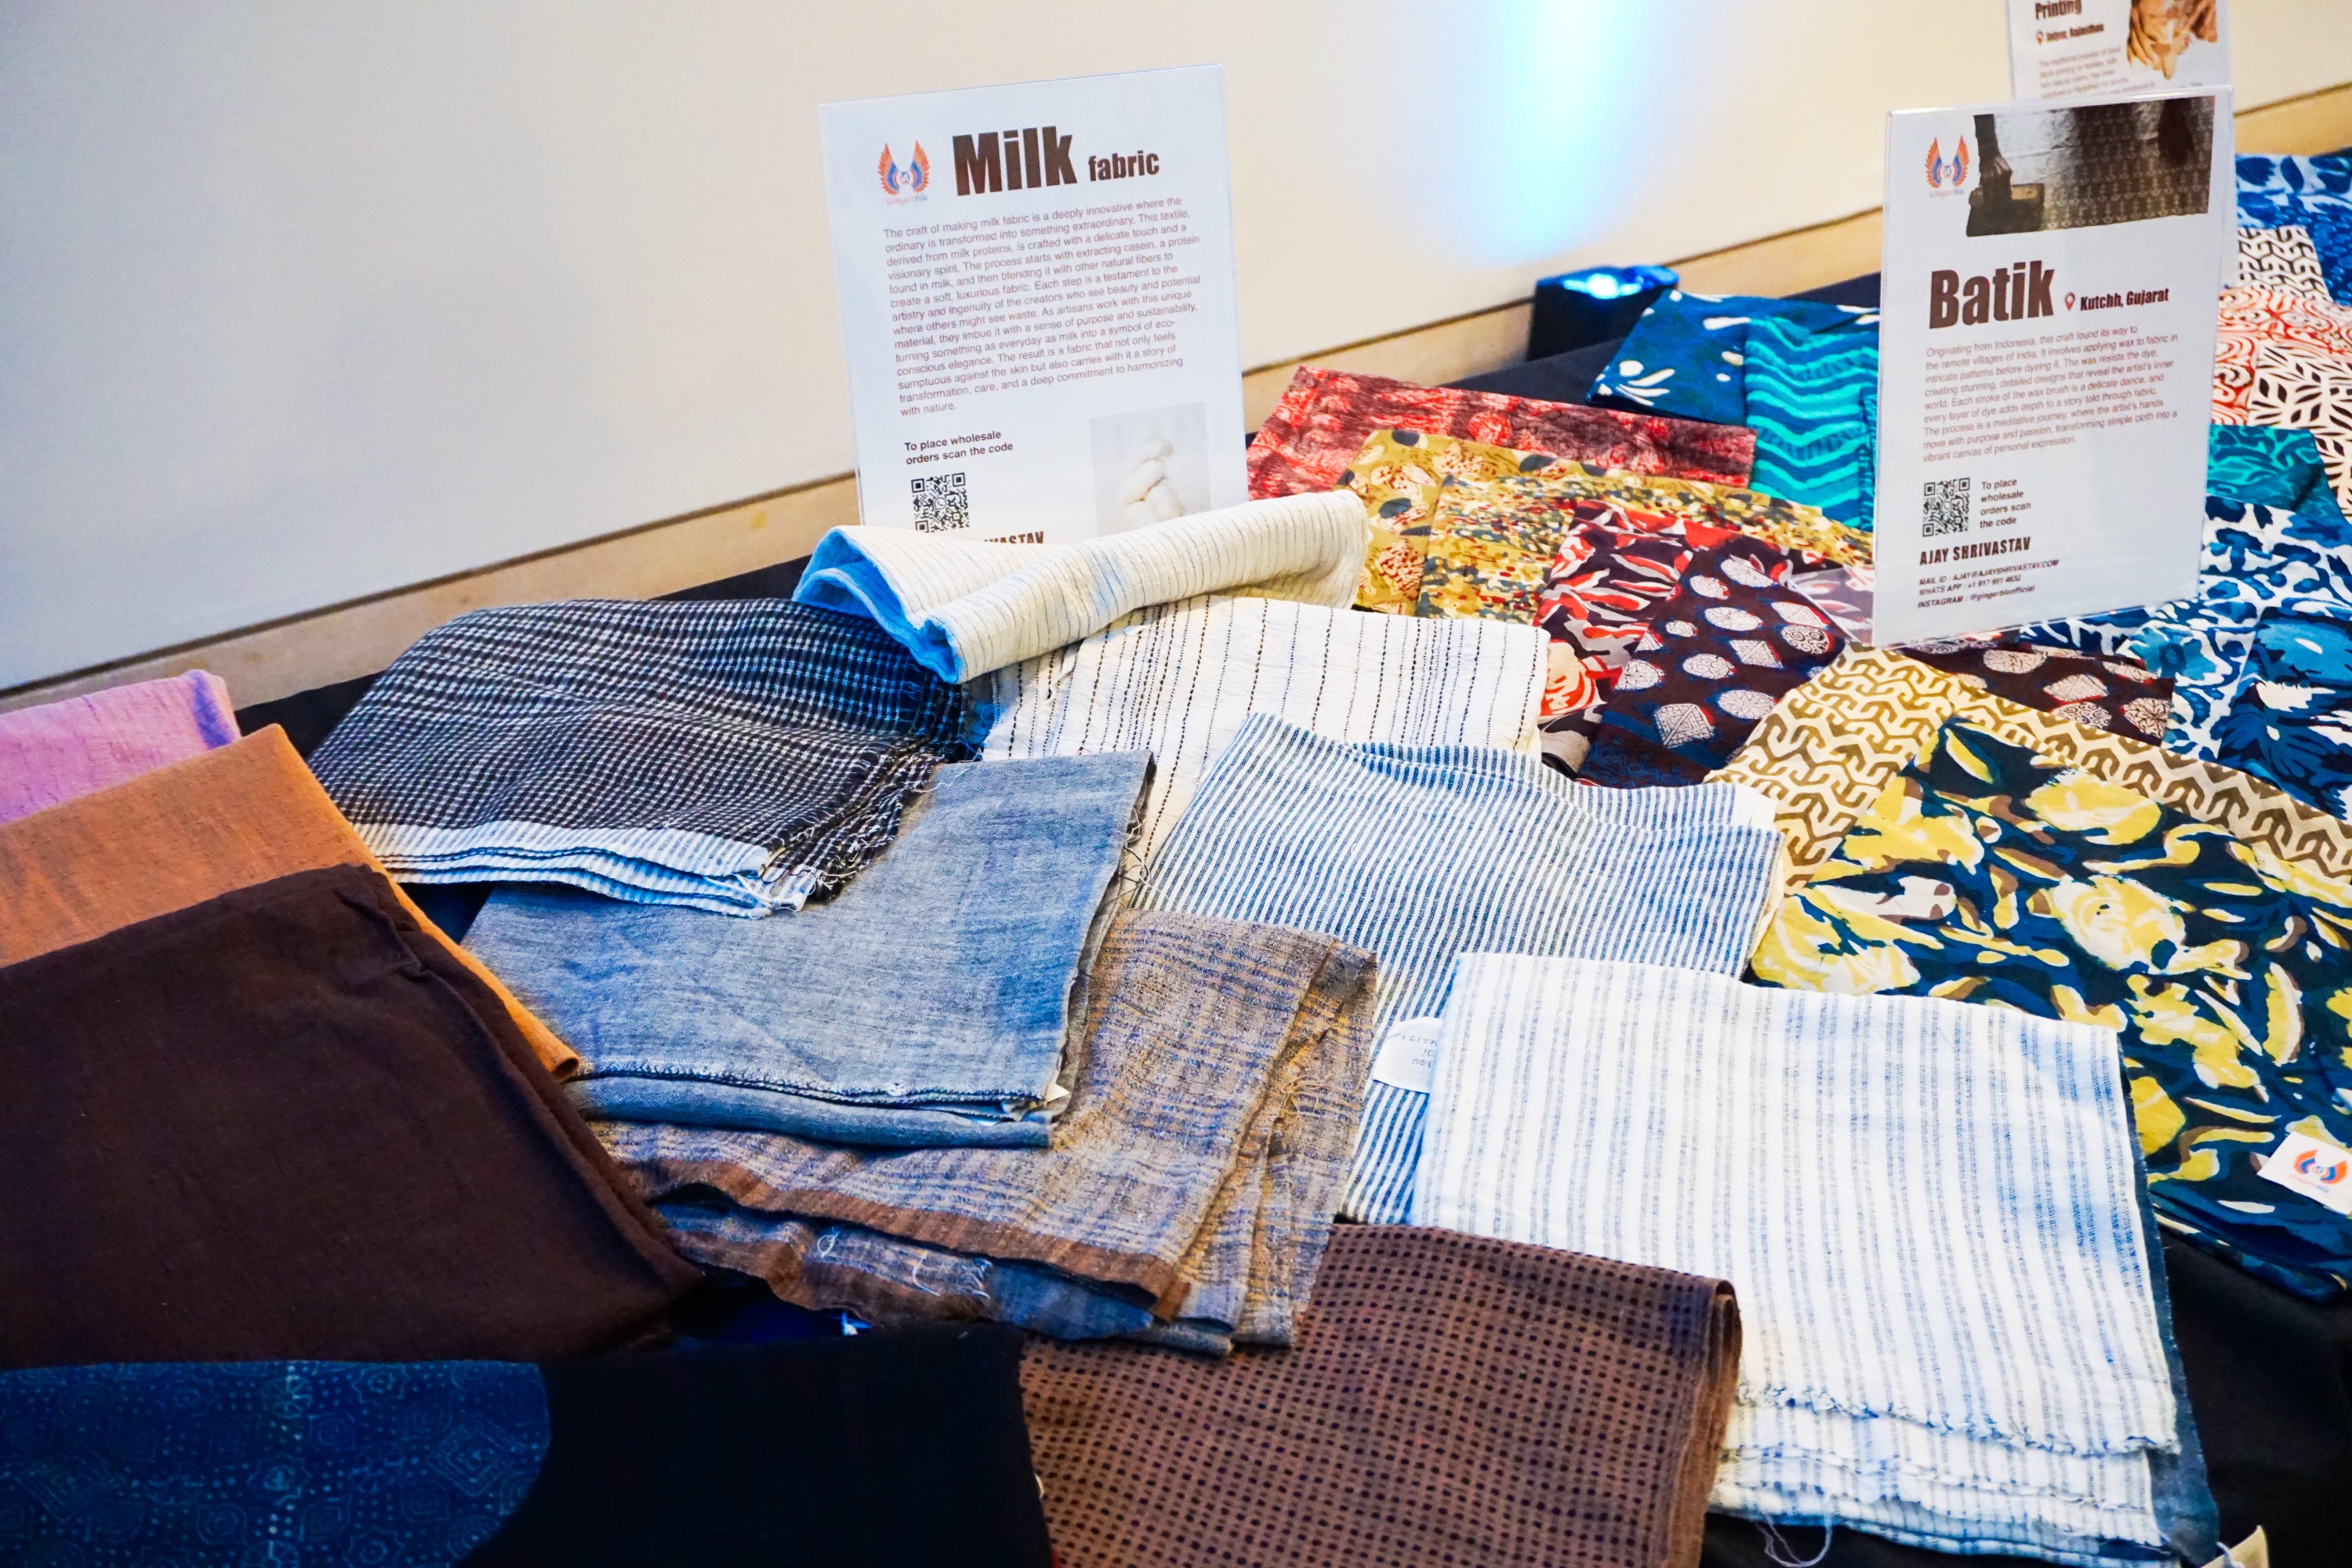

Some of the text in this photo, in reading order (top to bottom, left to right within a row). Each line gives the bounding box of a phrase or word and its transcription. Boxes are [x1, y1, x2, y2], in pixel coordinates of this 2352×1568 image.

[953, 126, 1159, 196] Milk fabric
[883, 197, 1181, 238] The craft of making milk fabric is a deeply innovative where the
[884, 241, 925, 252] ordinary
[927, 238, 937, 248] is
[938, 232, 997, 246] transformed
[999, 230, 1018, 239] into
[1019, 224, 1070, 237] something
[1137, 213, 1158, 223] This
[886, 254, 923, 267] derived
[925, 252, 948, 262] from
[950, 249, 971, 259] milk
[1016, 242, 1025, 251] is
[1027, 238, 1062, 249] crafted
[1062, 235, 1083, 245] with
[1093, 230, 1130, 242] delicate
[1131, 227, 1158, 238] touch
[1160, 223, 1179, 234] and
[887, 268, 931, 280] visionary
[962, 262, 982, 271] The
[984, 258, 1022, 270] process
[1025, 253, 1052, 264] starts
[1054, 250, 1073, 260] with
[1076, 245, 1121, 258] extracting
[1167, 236, 1200, 249] protein
[888, 282, 917, 294] found
[919, 281, 929, 290] in
[956, 275, 975, 286] and
[977, 274, 999, 284] then
[1000, 269, 1042, 281] blending
[1044, 267, 1051, 275] it
[1052, 264, 1073, 274] with
[1074, 262, 1098, 272] other
[1101, 256, 1134, 268] natural
[1135, 254, 1162, 263] fibers
[890, 297, 921, 308] create
[956, 288, 1000, 299] luxurious
[1034, 280, 1059, 290] Each
[1062, 278, 1083, 287] step
[1102, 269, 1149, 281] testament
[1151, 267, 1161, 276] to
[1163, 265, 1178, 274] the
[1929, 260, 2169, 328] Batik Kutchh, Gujarat
[1926, 345, 1972, 358] Originating
[1973, 343, 1993, 351] from
[2038, 336, 2054, 344] this
[2055, 332, 2074, 343] craft
[2076, 330, 2099, 340] found
[2111, 328, 2129, 336] way
[2129, 325, 2138, 334] to
[1926, 362, 1940, 371] the
[1940, 358, 1970, 368] remote
[1972, 354, 2004, 365] villages
[2005, 352, 2015, 361] of
[2041, 349, 2046, 358] It
[2048, 346, 2082, 356] involves
[2082, 342, 2117, 353] applying
[2146, 336, 2169, 345] fabric
[1924, 386, 1958, 397] creating
[1999, 376, 2033, 388] detailed
[2034, 373, 2067, 384] designs
[2067, 370, 2084, 380] that
[2085, 367, 2110, 377] reveal
[2125, 362, 2152, 372] artist's
[2153, 360, 2174, 368] inner
[1925, 373, 1958, 383] intricate
[1959, 369, 1994, 381] patterns
[1995, 365, 2023, 376] before
[2024, 362, 2052, 373] dyeing
[2064, 358, 2079, 367] The
[2098, 353, 2125, 363] resists
[2126, 351, 2140, 360] the
[903, 430, 1001, 452] To place wholesale
[906, 442, 1014, 464] orders scan the code
[1980, 479, 2018, 490] To place
[1980, 490, 2024, 503] wholesale
[1979, 516, 2017, 528] the code
[1980, 503, 2031, 516] orders scan
[1919, 536, 2031, 565] AJAY SHRIVASTAV
[1918, 596, 1964, 608] INSTAGRAM
